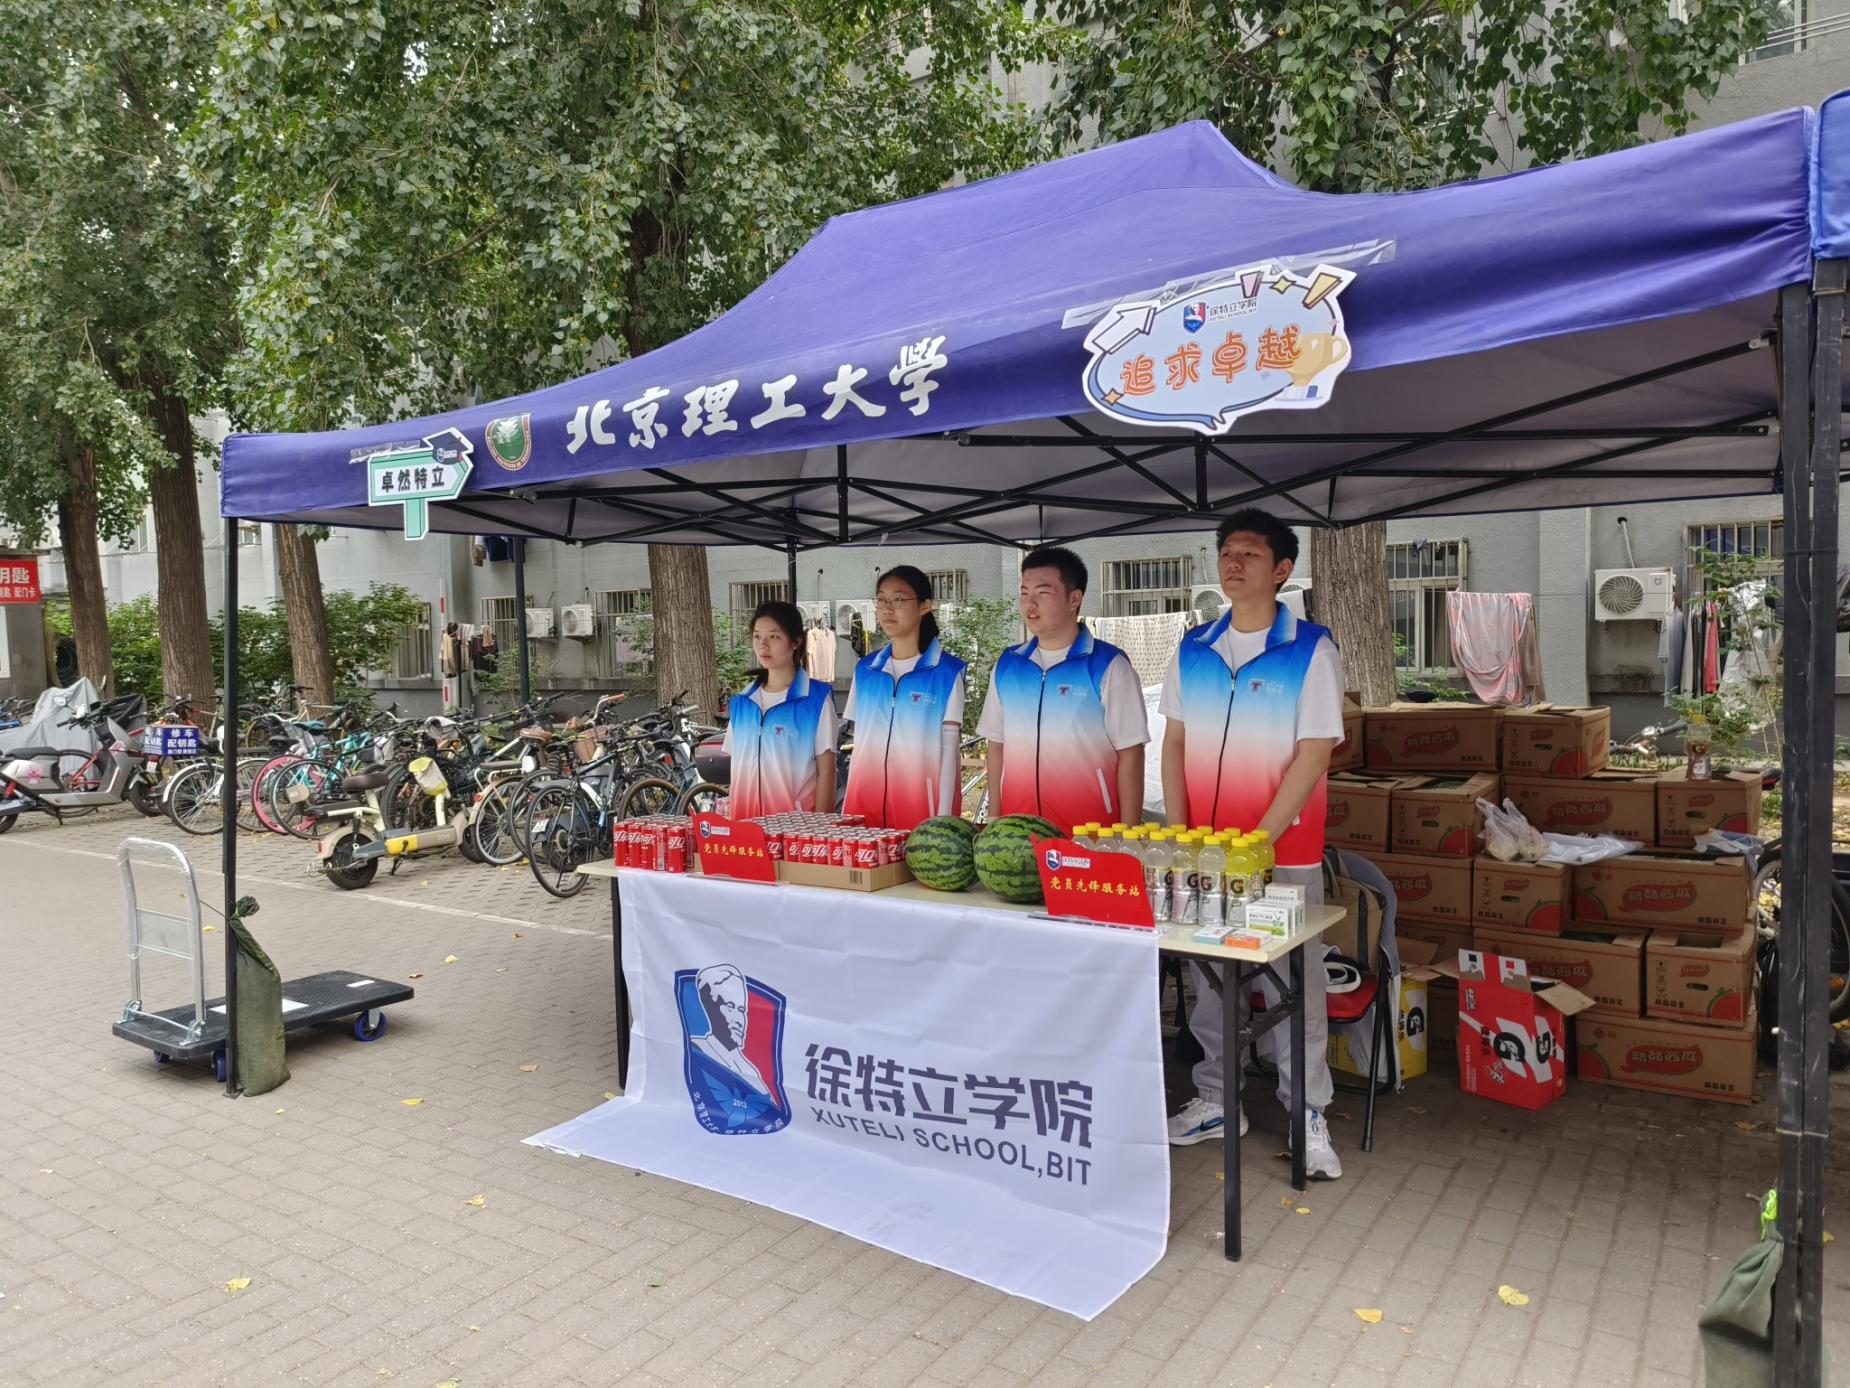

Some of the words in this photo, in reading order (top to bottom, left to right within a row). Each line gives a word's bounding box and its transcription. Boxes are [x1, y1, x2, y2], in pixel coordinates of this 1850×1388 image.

[1119, 324, 1302, 396] 追求卓越
[381, 466, 445, 493] 卓然特立
[167, 738, 197, 748] 配钥匙
[704, 842, 764, 857] 党员先锋服务站
[1050, 875, 1140, 897] 党员先锋服务站
[1201, 876, 1212, 891] G
[1231, 879, 1244, 894] G
[732, 1099, 748, 1109] 2013
[804, 1042, 1093, 1149] 徐特立学院
[811, 1106, 906, 1142] XUTELI
[915, 1127, 1092, 1187] SCHOOL,BIT
